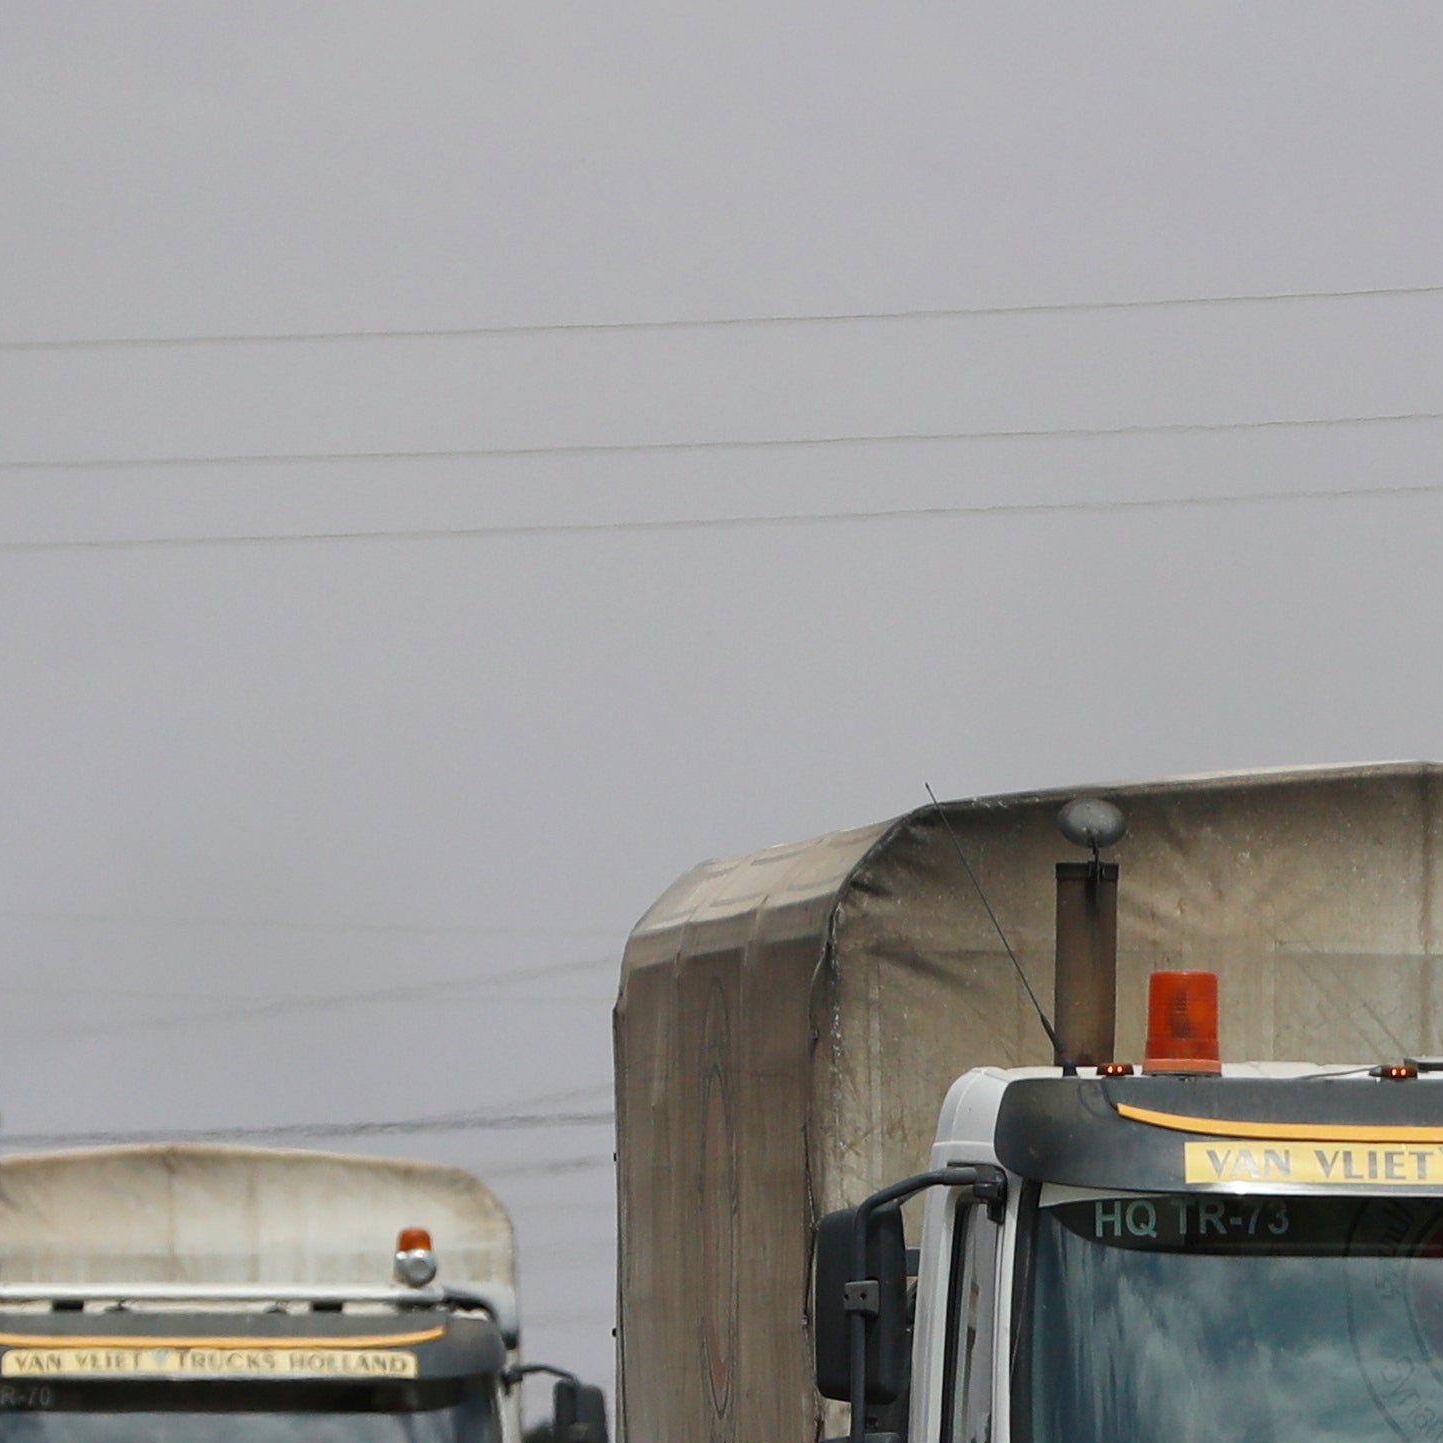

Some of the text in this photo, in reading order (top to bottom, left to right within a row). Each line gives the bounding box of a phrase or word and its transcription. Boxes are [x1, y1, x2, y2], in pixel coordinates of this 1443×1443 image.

[1207, 1149, 1291, 1178] VAN
[1313, 1150, 1434, 1180] VLIET
[1095, 1200, 1290, 1238] HQ TR-73
[177, 1352, 276, 1371] TRUCKS
[288, 1353, 407, 1375] HOLLAND
